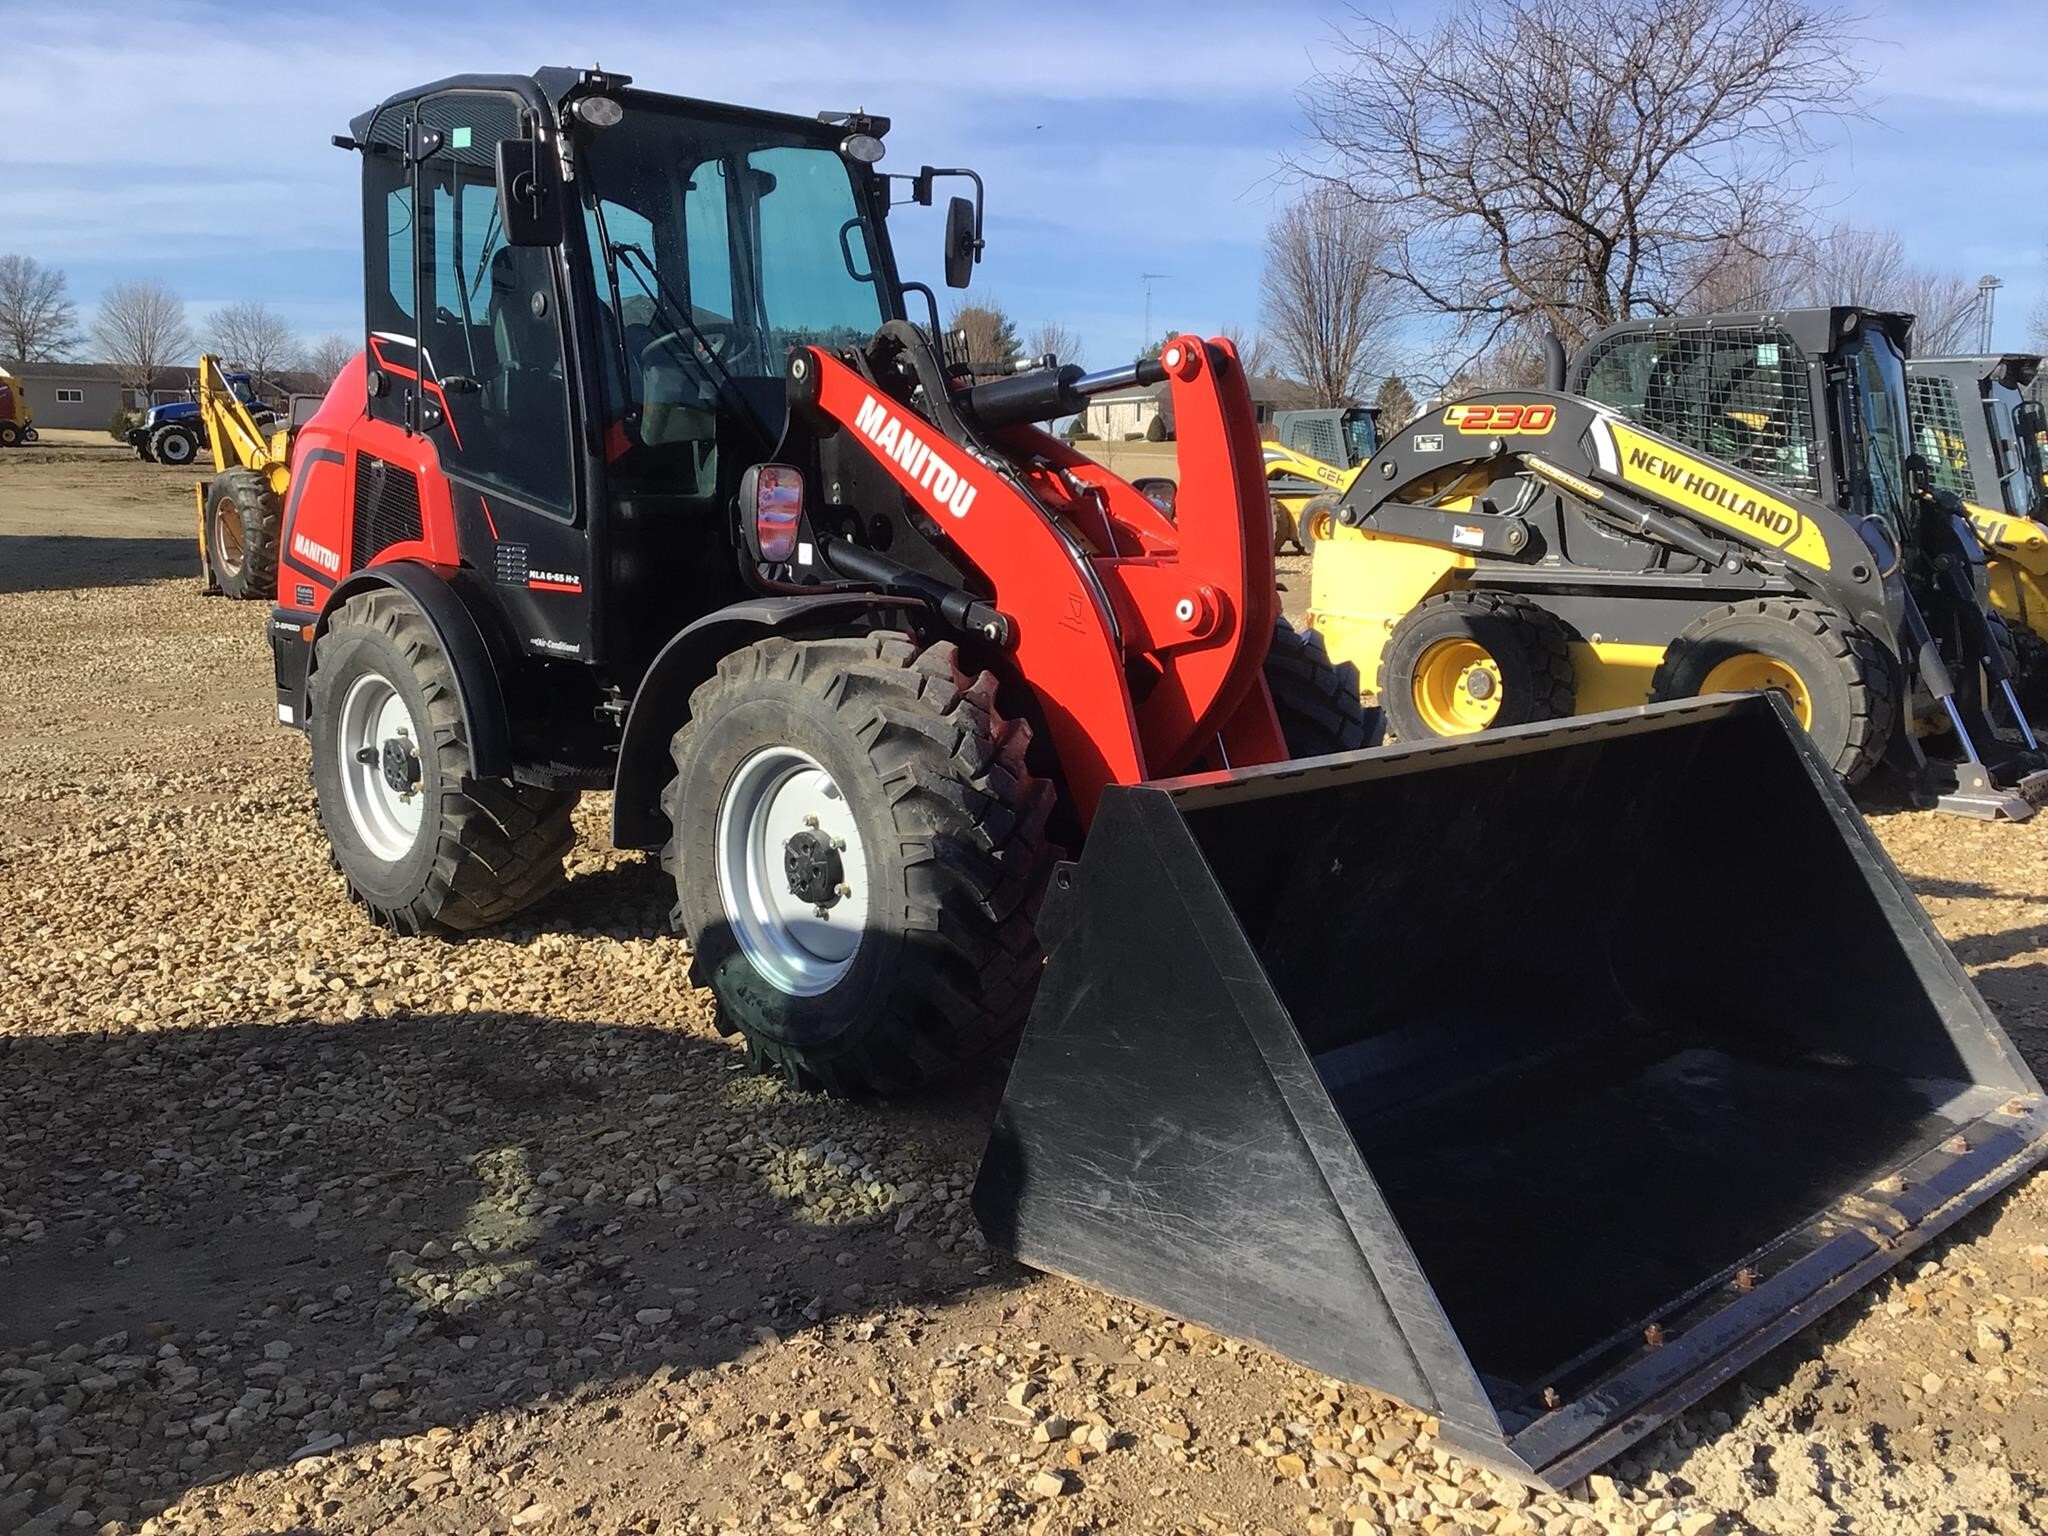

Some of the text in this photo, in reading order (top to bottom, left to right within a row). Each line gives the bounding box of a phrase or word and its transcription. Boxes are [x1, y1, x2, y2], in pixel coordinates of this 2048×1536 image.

[854, 394, 977, 518] MANITOU
[1317, 466, 1345, 487] GEH
[1629, 448, 1683, 485] NEW
[1683, 472, 1793, 536] HOLLAND
[294, 533, 340, 572] MANITOU
